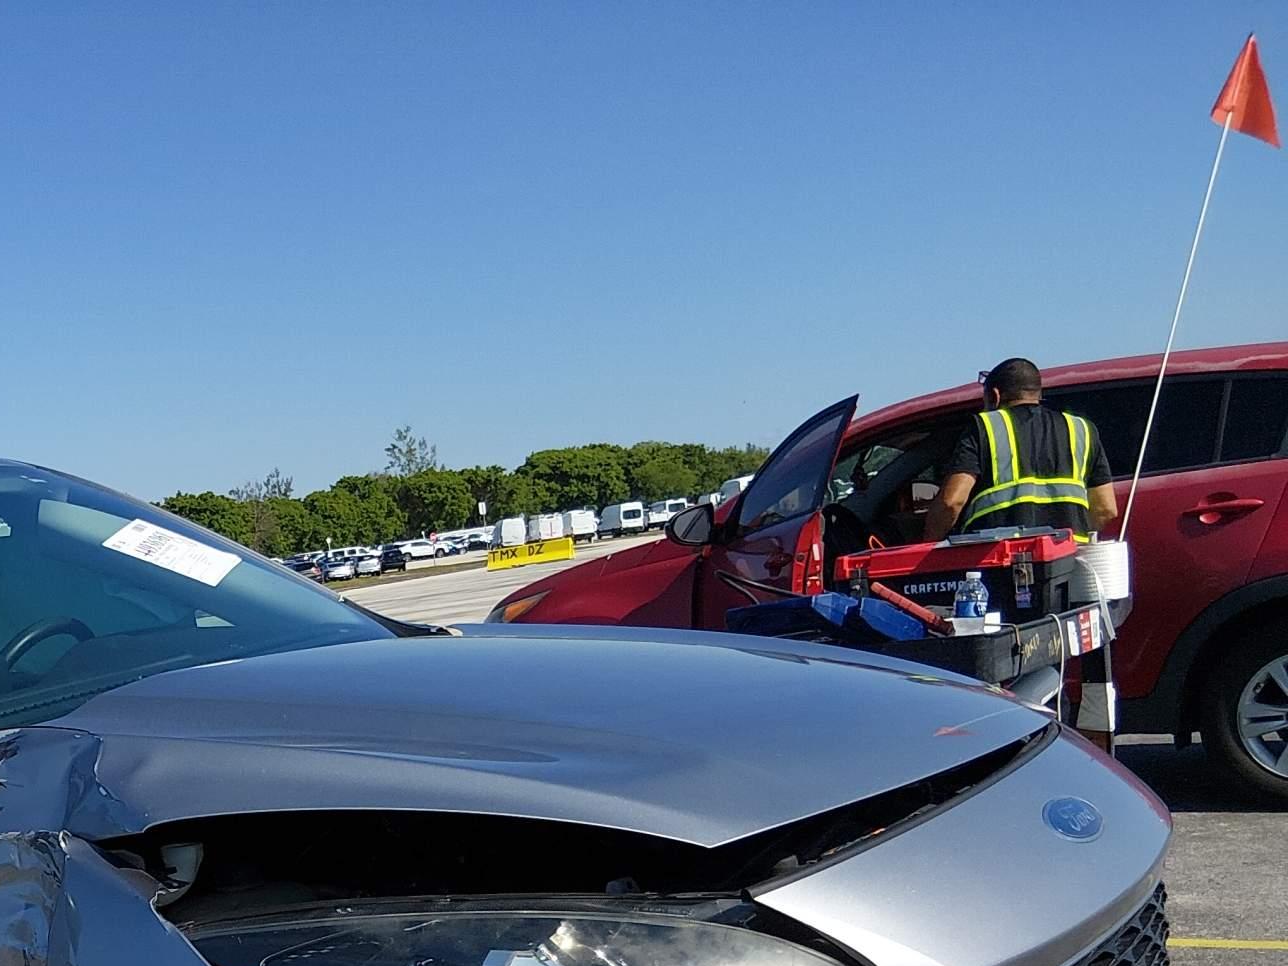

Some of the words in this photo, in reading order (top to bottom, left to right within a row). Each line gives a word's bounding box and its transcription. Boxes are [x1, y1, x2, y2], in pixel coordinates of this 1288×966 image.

[489, 548, 518, 563] TMX
[527, 543, 545, 557] DZ
[904, 580, 968, 595] CRAFTSMA
